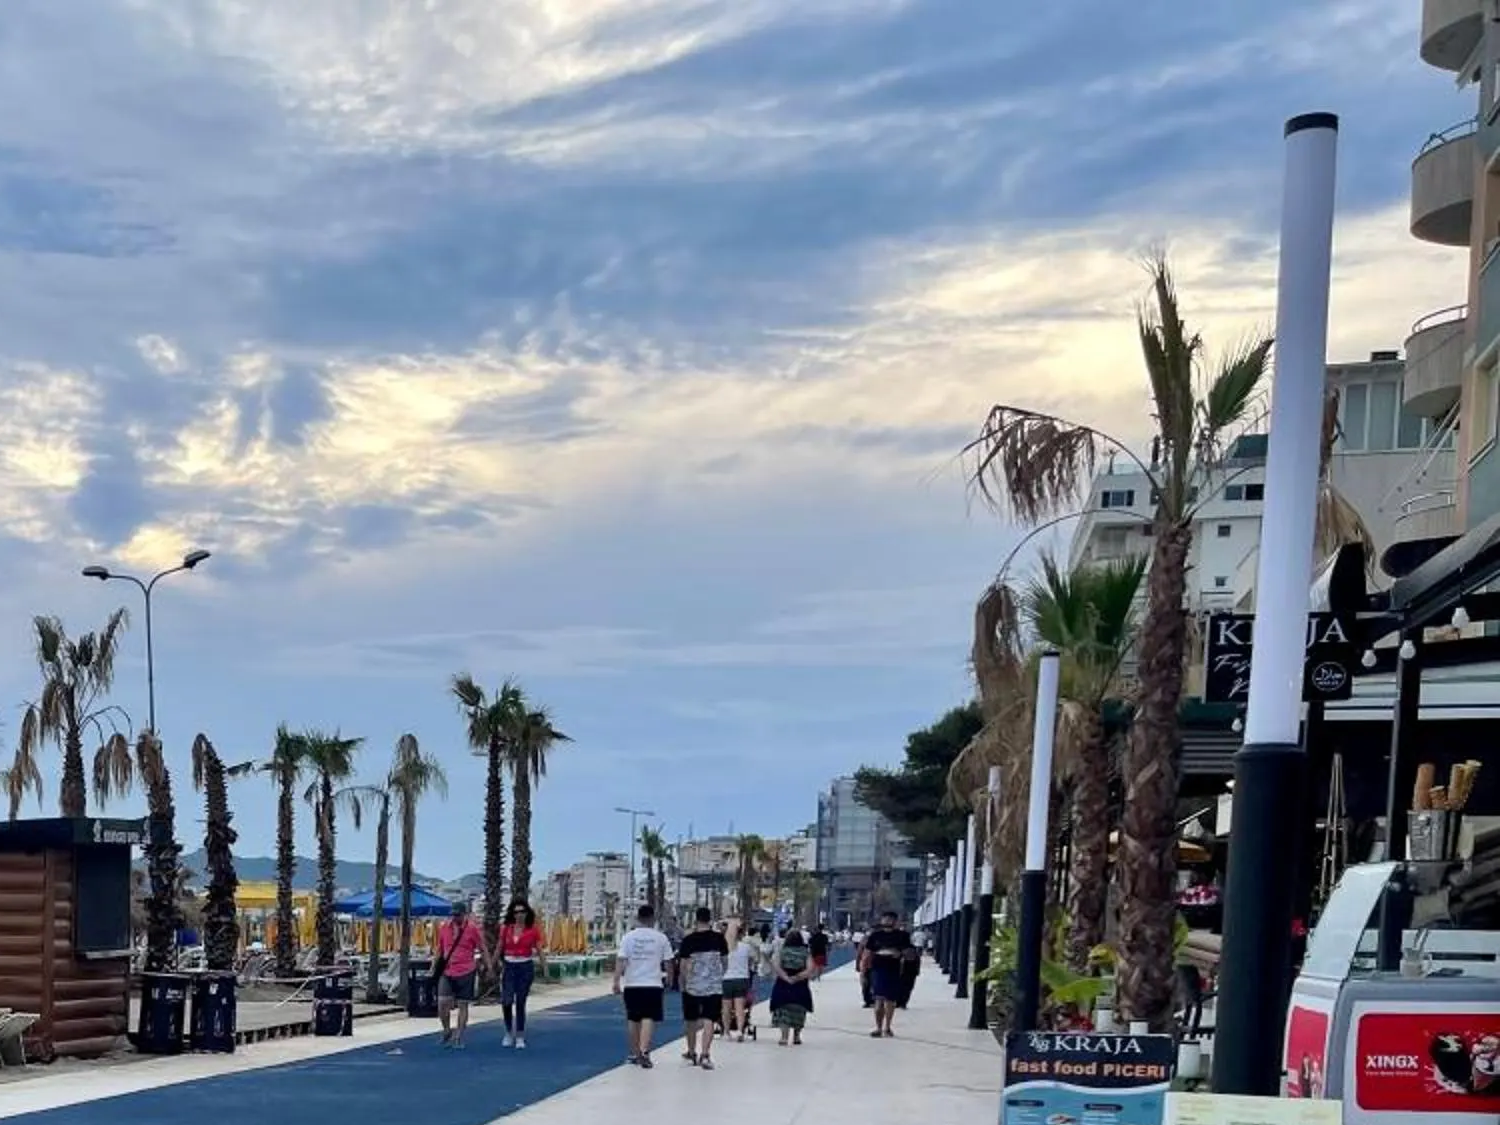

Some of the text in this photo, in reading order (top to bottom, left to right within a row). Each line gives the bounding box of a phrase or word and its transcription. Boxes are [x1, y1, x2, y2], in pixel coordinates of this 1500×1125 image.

[1216, 618, 1349, 649] KJA
[1054, 1035, 1142, 1055] KRAJA
[1011, 1058, 1165, 1079] fast food PICERI
[1366, 1055, 1419, 1069] XINGX
